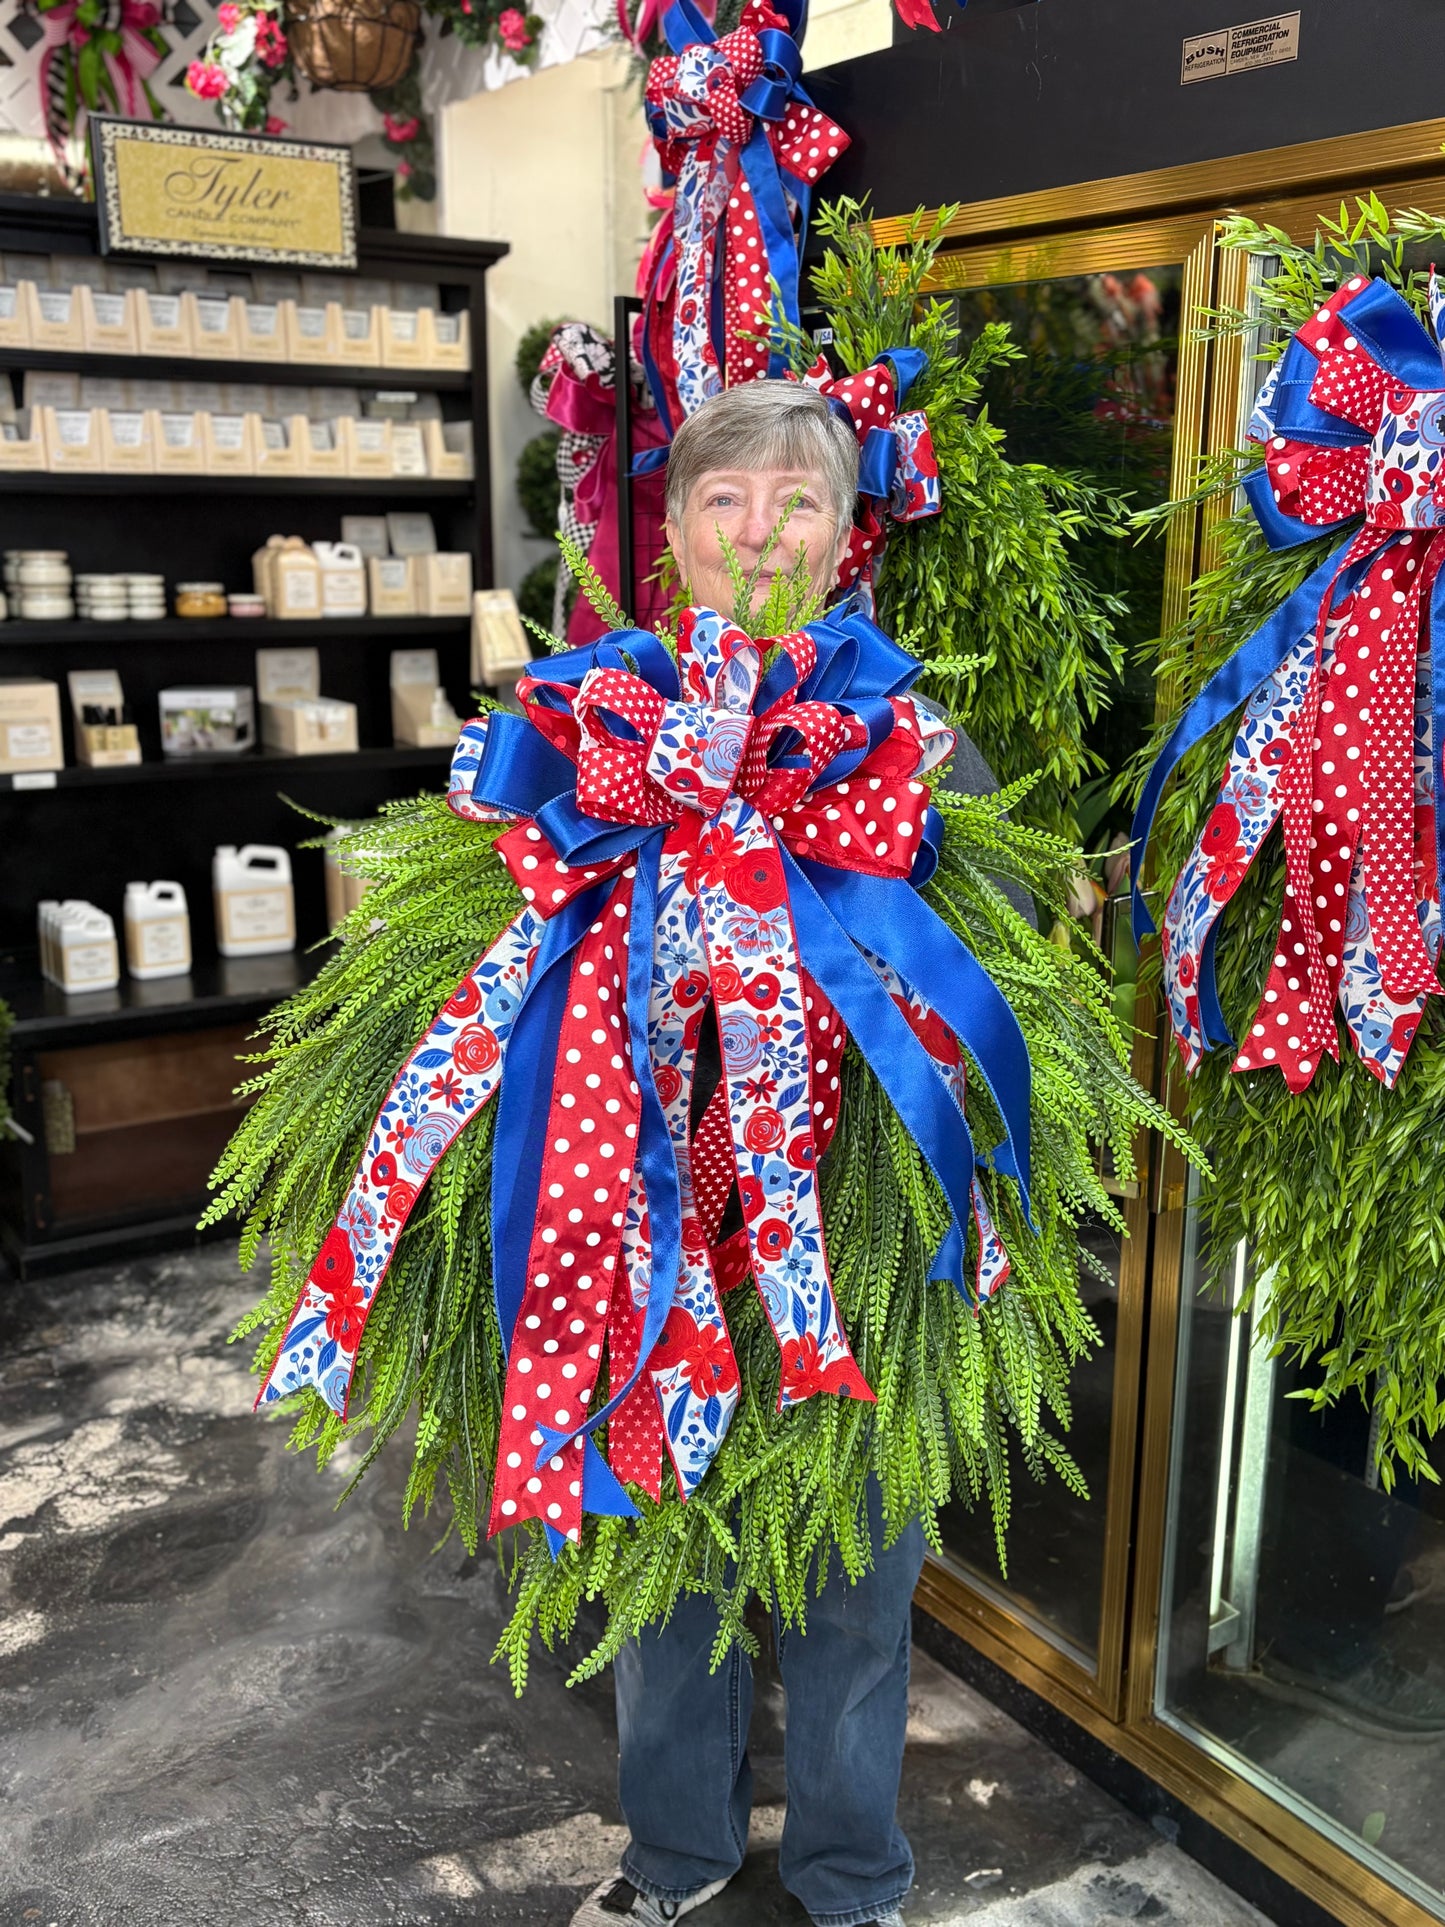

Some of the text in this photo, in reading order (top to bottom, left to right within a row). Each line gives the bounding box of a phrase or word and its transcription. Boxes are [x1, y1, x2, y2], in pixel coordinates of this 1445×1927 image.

[1231, 22, 1281, 40] COMMERCIAL
[1231, 29, 1290, 49] REFRIGERATION
[1185, 46, 1225, 65] BUSH
[1230, 42, 1274, 59] EQUIPMENT
[1184, 57, 1225, 71] REFRIGERATION
[164, 155, 292, 220] Tyler
